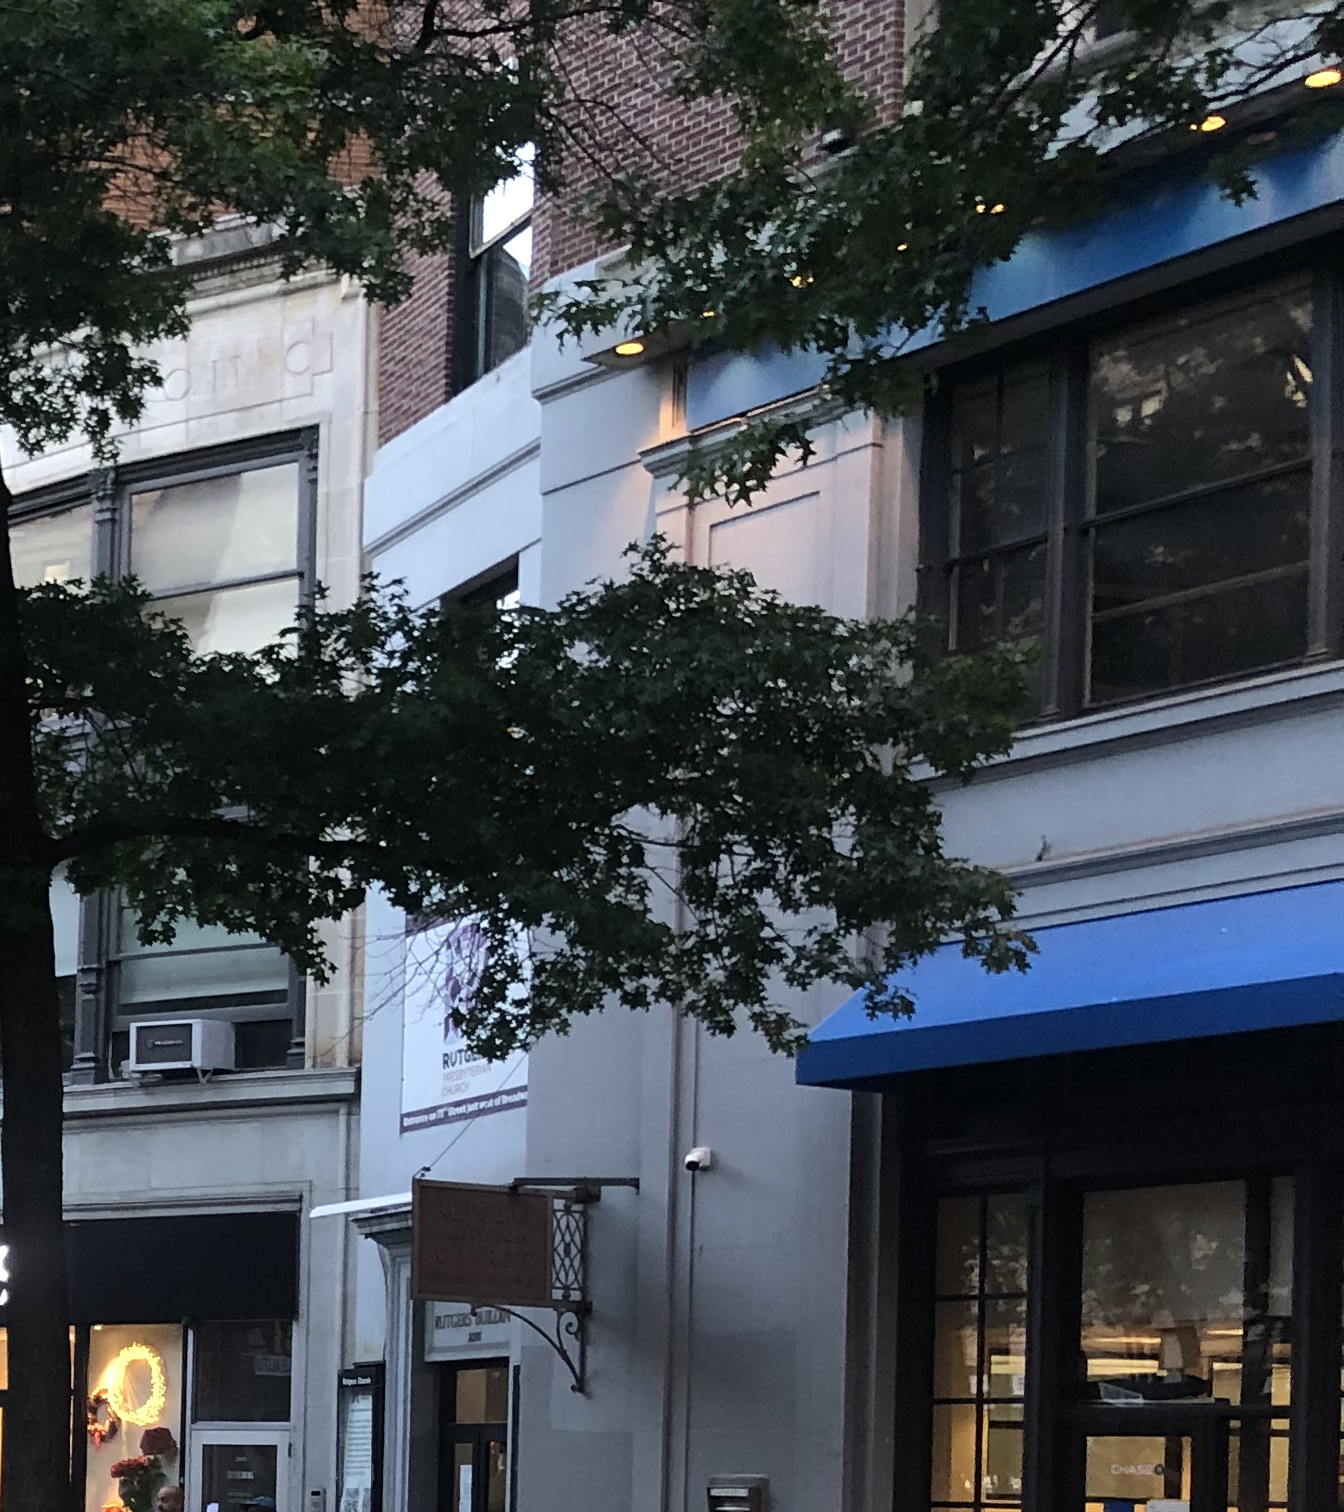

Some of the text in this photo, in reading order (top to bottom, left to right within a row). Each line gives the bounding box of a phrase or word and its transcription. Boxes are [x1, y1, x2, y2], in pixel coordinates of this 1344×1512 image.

[441, 1082, 470, 1097] CHURCH
[475, 1309, 511, 1326] BUILDIN
[1111, 1464, 1154, 1475] CHASE
